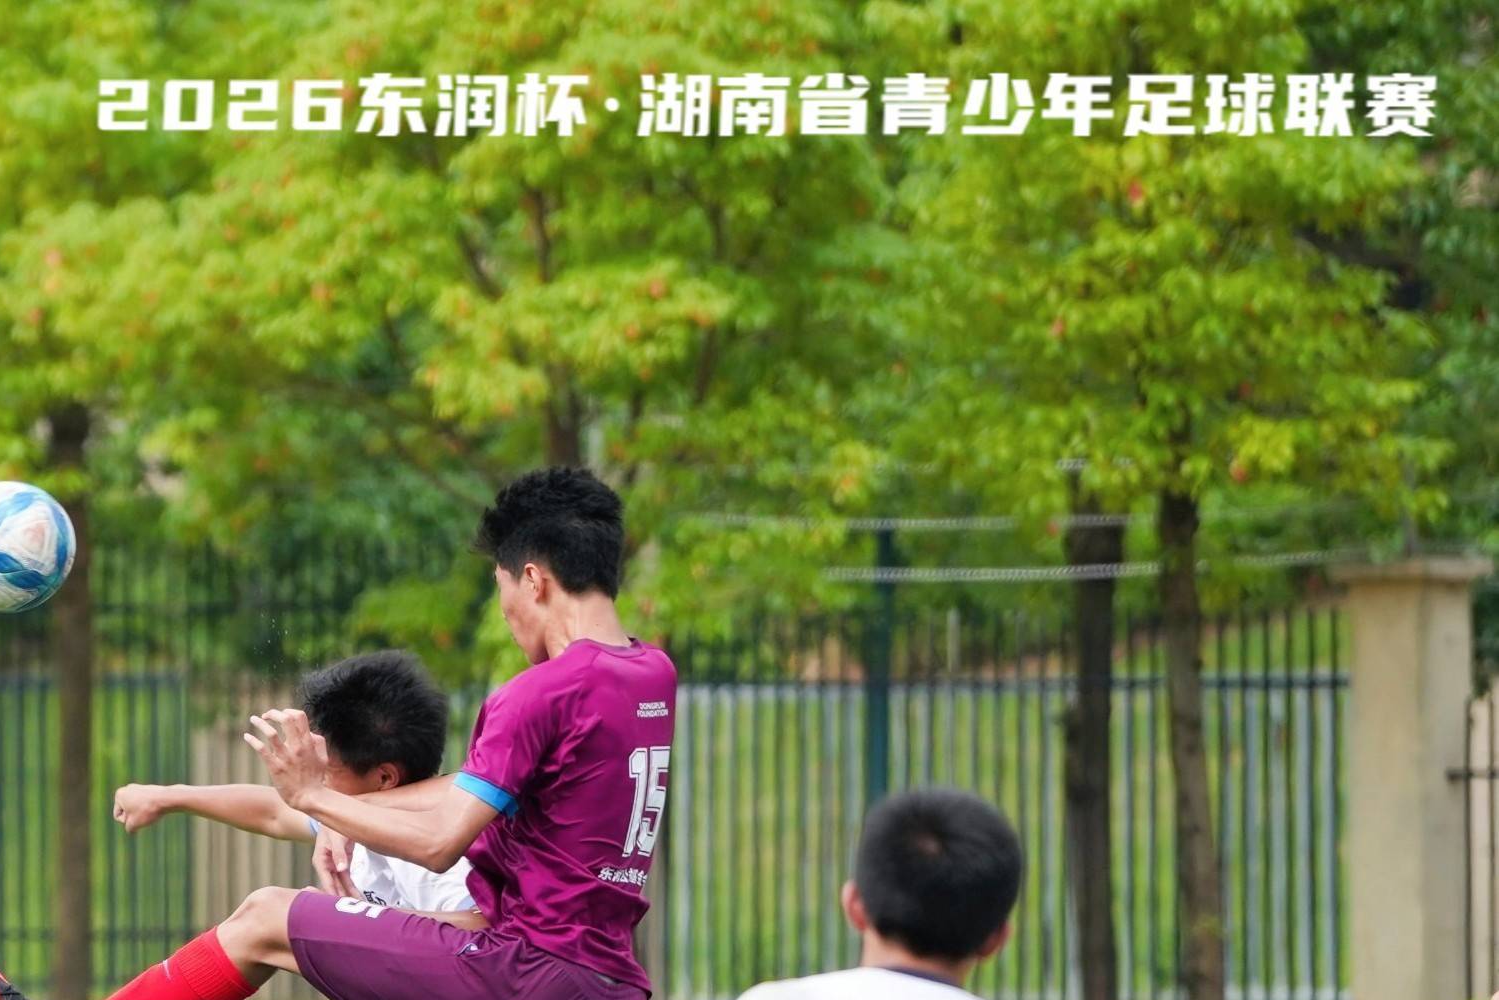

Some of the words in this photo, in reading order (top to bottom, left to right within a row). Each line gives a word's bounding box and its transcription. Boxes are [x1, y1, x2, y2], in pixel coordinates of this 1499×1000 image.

[638, 702, 666, 710] DONGRUN
[636, 709, 668, 717] FOUNDATION
[622, 746, 671, 857] 15
